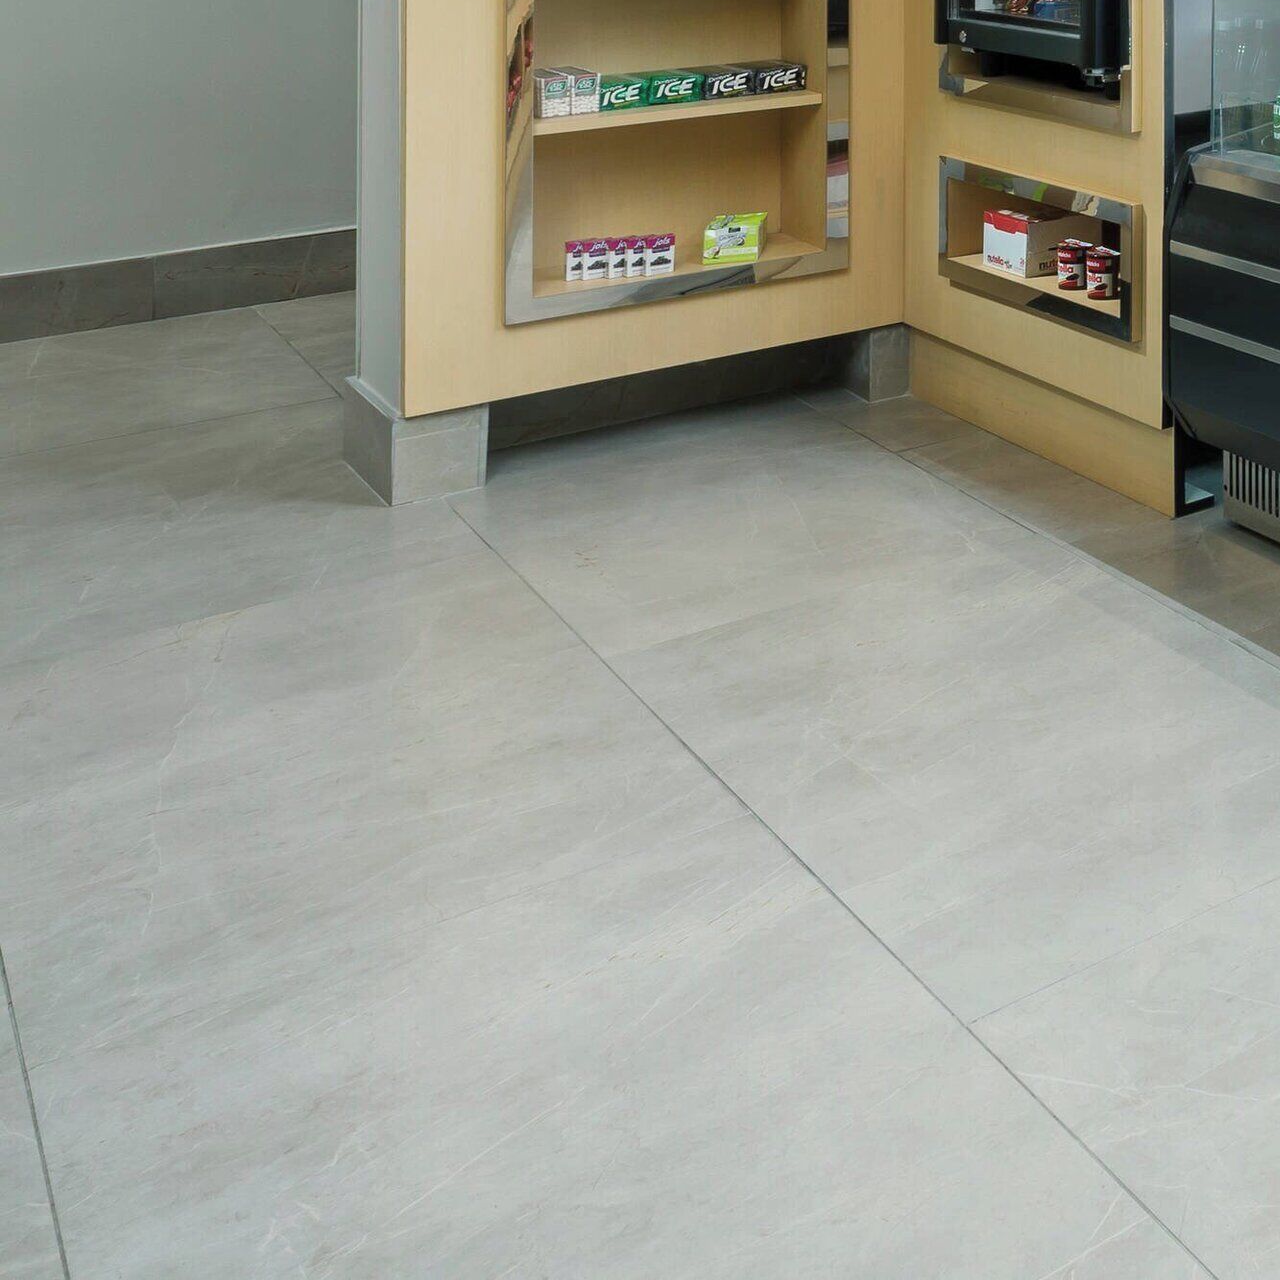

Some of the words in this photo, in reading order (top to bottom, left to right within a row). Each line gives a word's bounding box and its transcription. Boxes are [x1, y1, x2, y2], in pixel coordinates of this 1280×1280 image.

[656, 77, 696, 98] ICE
[711, 72, 750, 95] ICE
[762, 68, 799, 89] ICE
[602, 84, 641, 107] ICE
